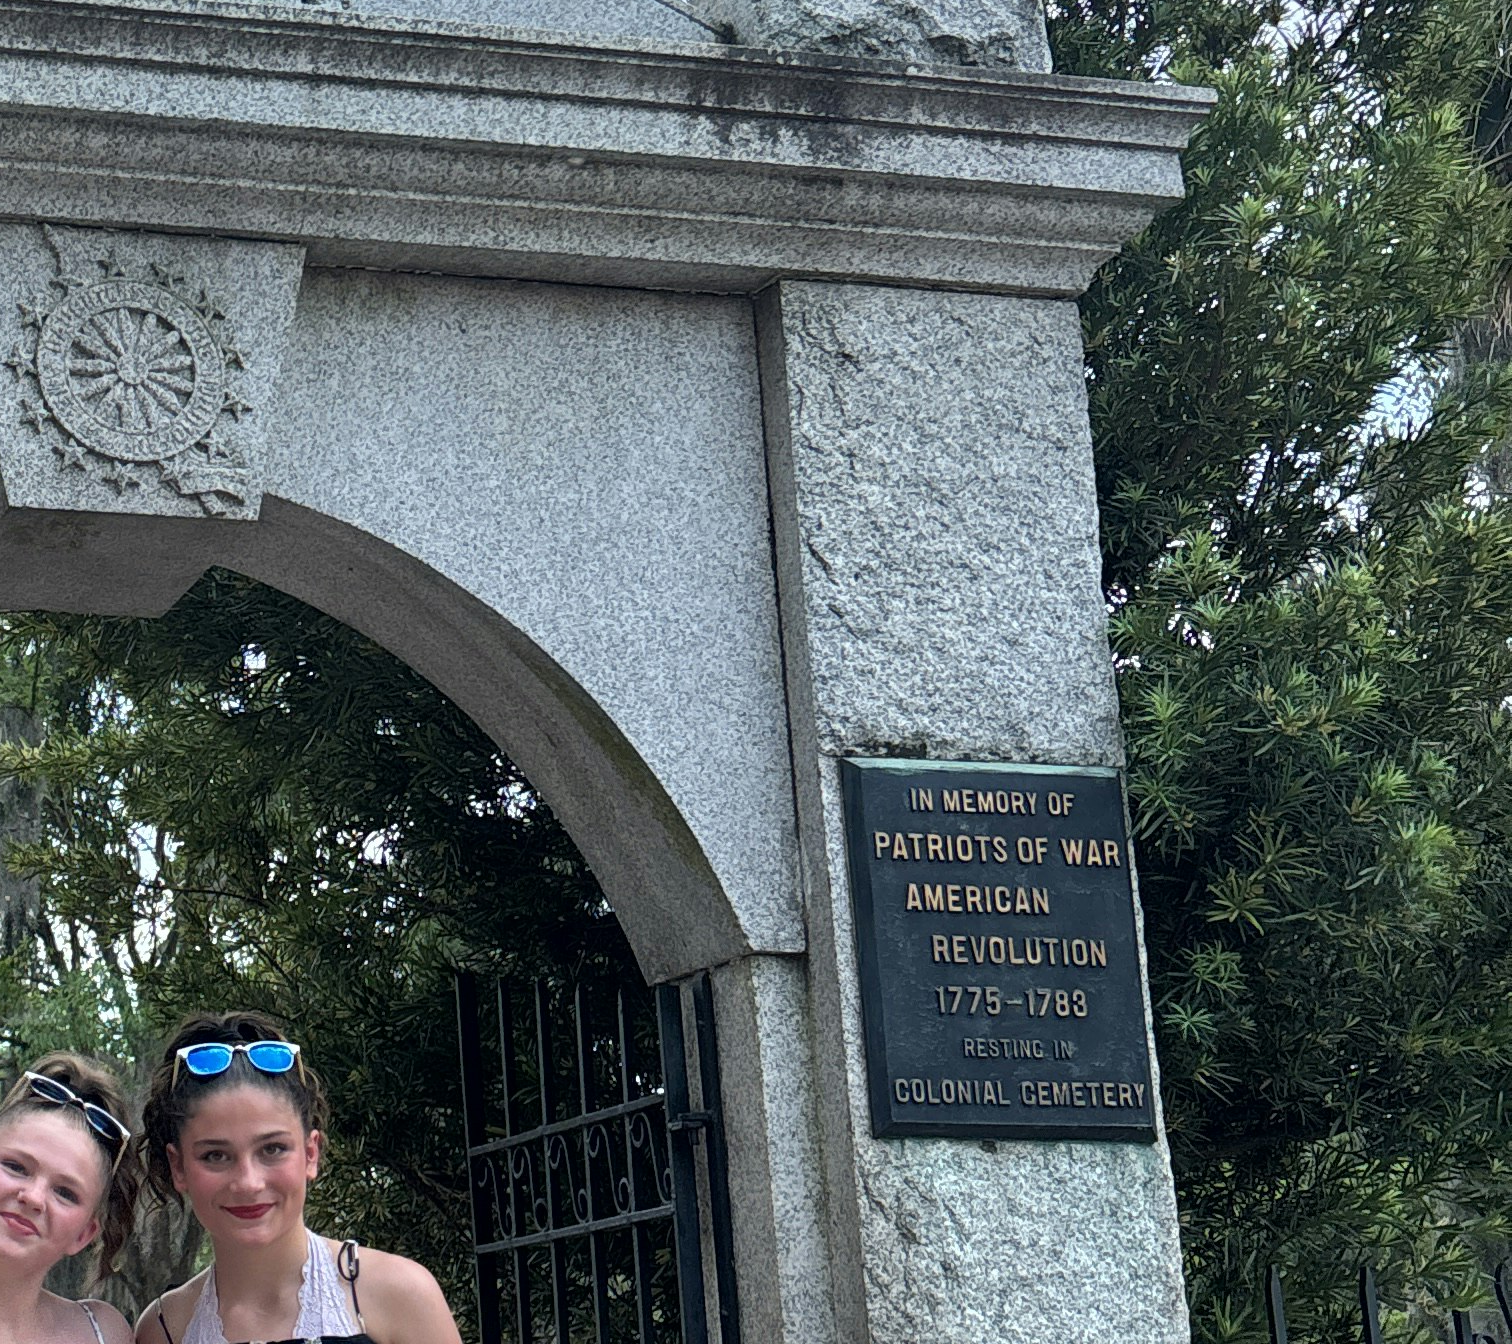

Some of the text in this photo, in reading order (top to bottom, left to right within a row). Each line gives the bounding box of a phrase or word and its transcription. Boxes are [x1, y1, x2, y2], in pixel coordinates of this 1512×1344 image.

[909, 787, 1075, 817] IN MEMORY OF
[874, 831, 1121, 868] PATRIOTS OF WAR
[906, 882, 1050, 916] AMERICAN
[931, 933, 1107, 968] REVOLUTION
[962, 1037, 1073, 1060] RESTING IN
[894, 1077, 1146, 1109] COLONIAL CEMETERY
